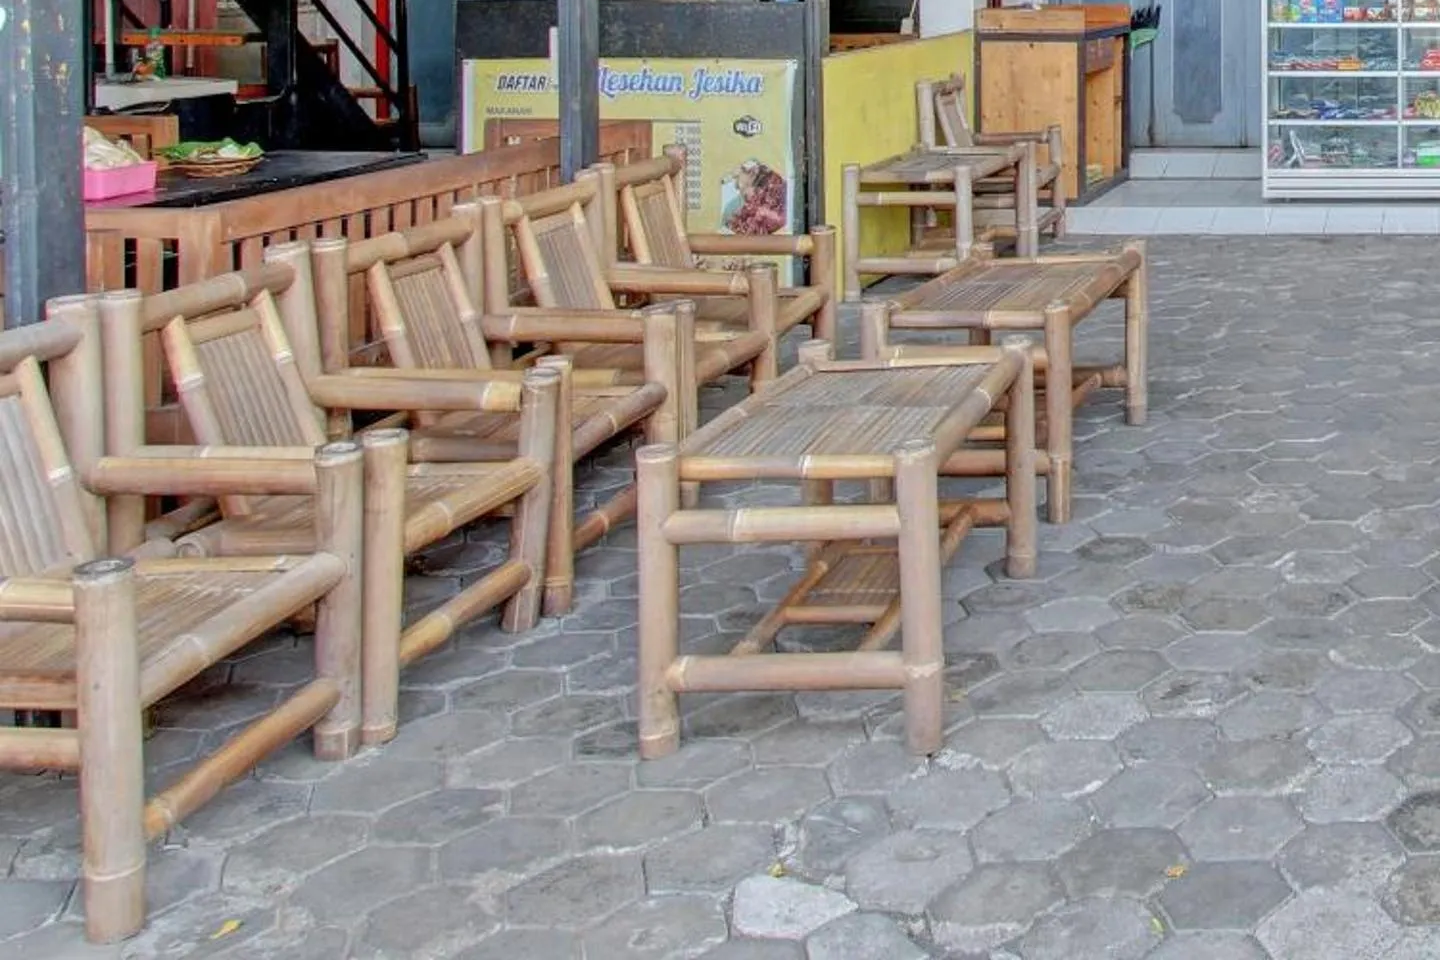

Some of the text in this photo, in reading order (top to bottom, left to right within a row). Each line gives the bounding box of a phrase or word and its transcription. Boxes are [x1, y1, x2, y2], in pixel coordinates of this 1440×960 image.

[496, 74, 547, 91] DAFTAR
[600, 67, 761, 99] Lesehan Jesika
